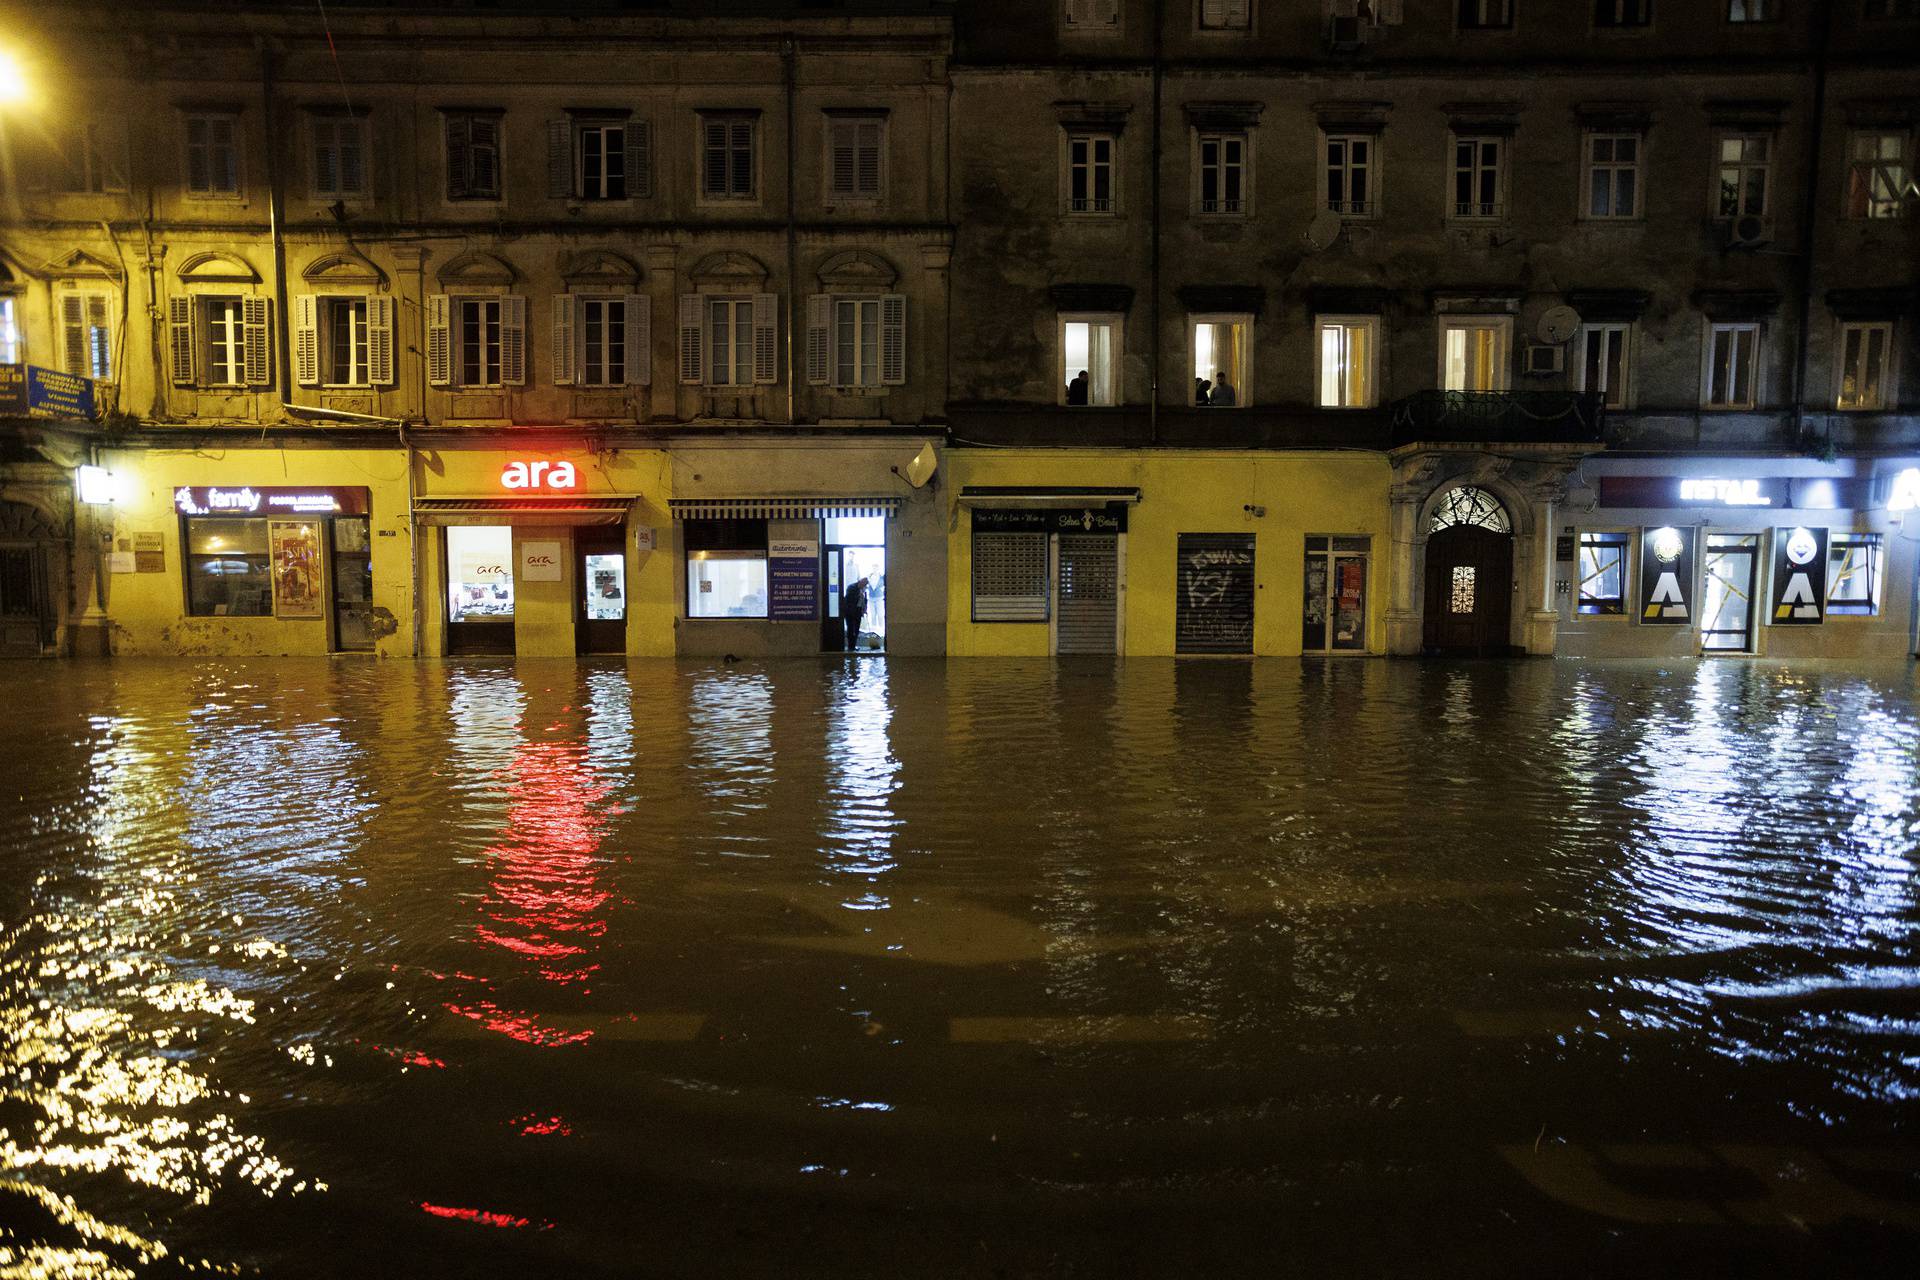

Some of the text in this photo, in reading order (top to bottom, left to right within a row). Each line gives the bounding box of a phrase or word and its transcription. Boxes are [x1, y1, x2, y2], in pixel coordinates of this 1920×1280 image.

[500, 460, 576, 489] ara
[208, 488, 261, 512] family
[527, 555, 557, 564] ara
[477, 565, 511, 576] ara
